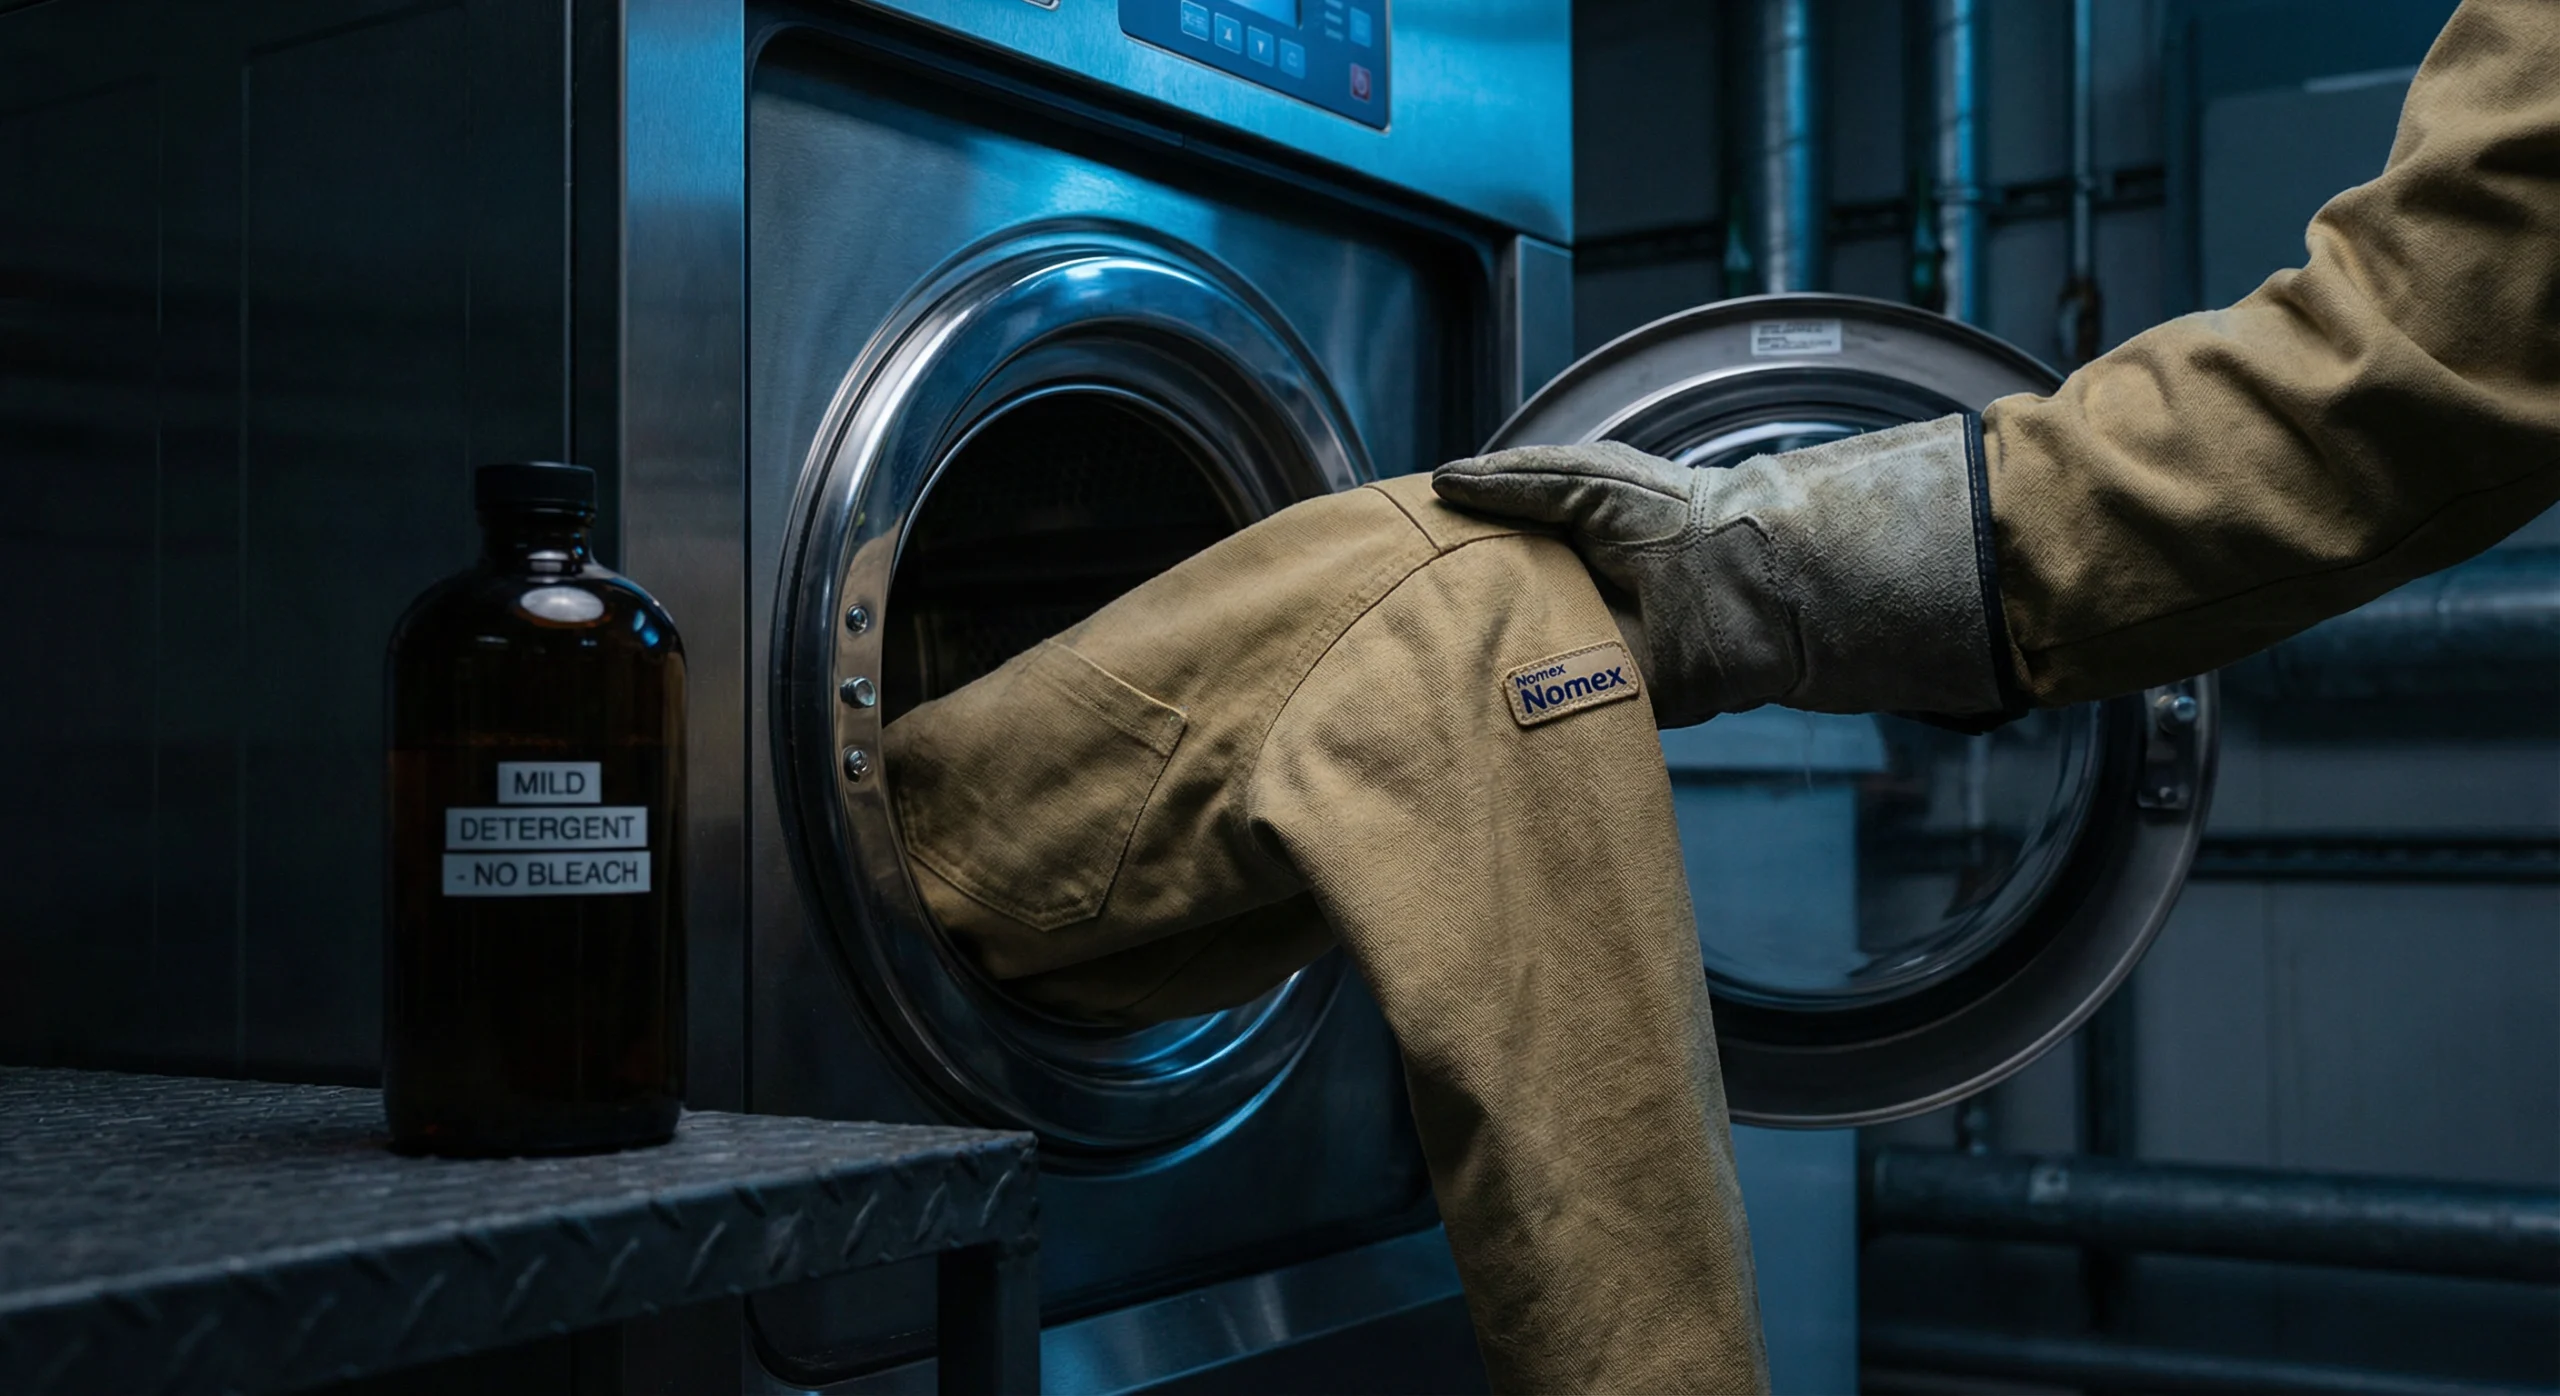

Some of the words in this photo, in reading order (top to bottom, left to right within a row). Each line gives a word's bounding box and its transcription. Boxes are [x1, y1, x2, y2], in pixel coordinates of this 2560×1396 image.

[1515, 664, 1566, 689] Nomex
[1520, 666, 1627, 714] Nomex
[514, 771, 585, 795] MILD
[460, 816, 635, 841] DETERGENT
[475, 862, 518, 886] NO
[528, 860, 639, 886] BLEACH
